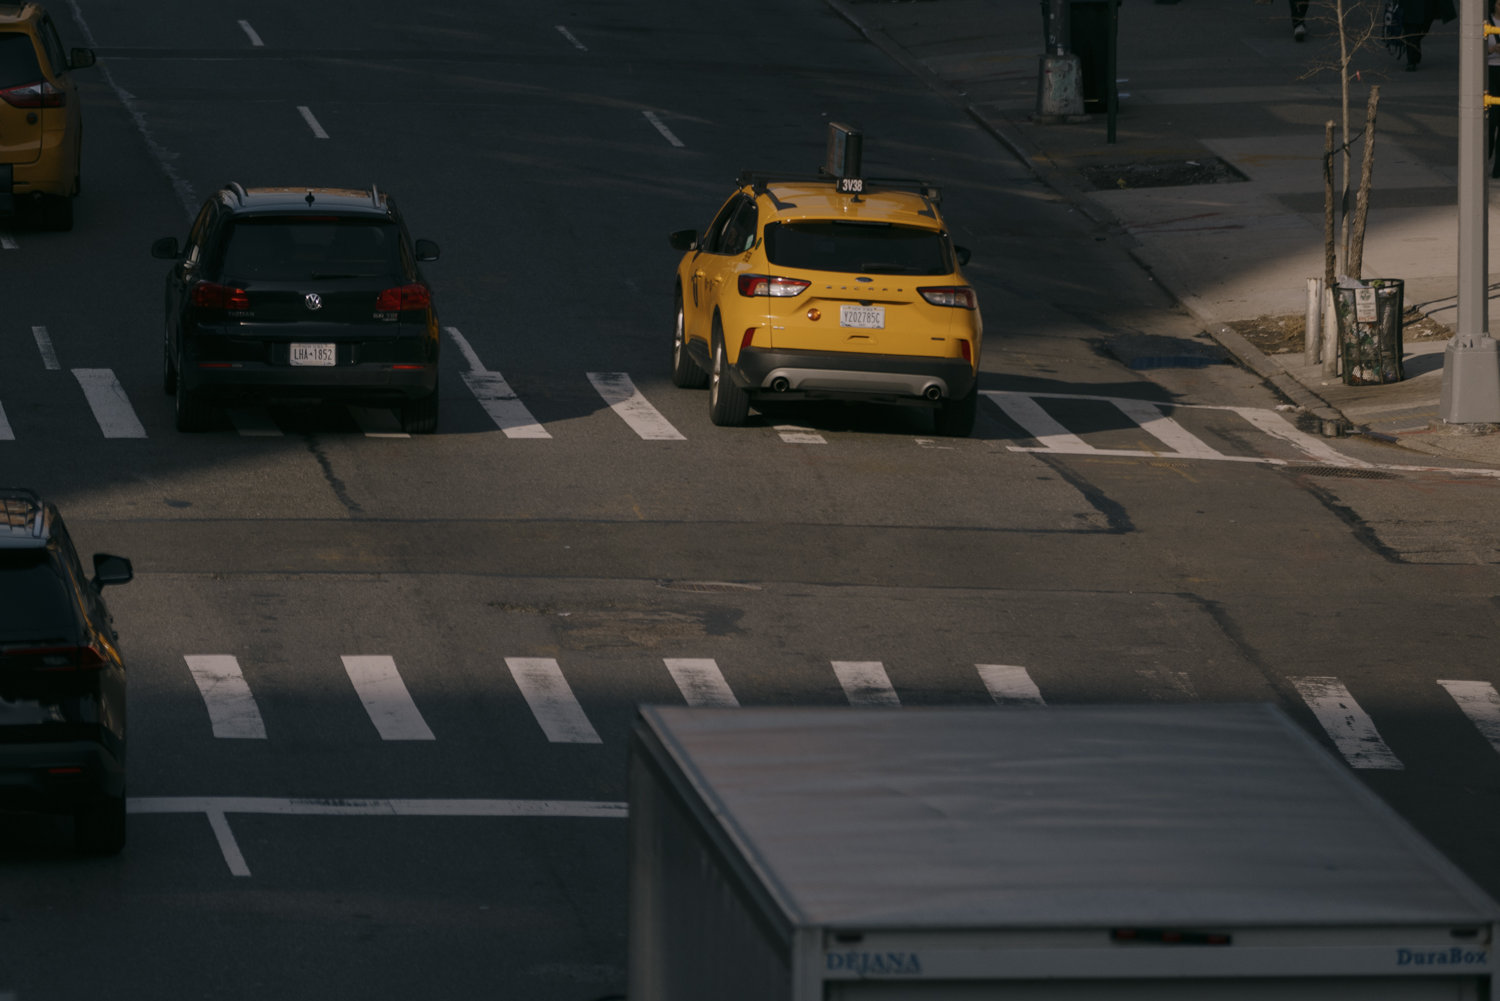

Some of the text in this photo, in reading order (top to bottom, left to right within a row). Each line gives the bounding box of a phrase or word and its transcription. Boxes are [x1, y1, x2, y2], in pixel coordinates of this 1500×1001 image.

[842, 179, 862, 191] 3V38
[844, 311, 880, 324] Y202785C
[1396, 947, 1487, 965] DuraBox
